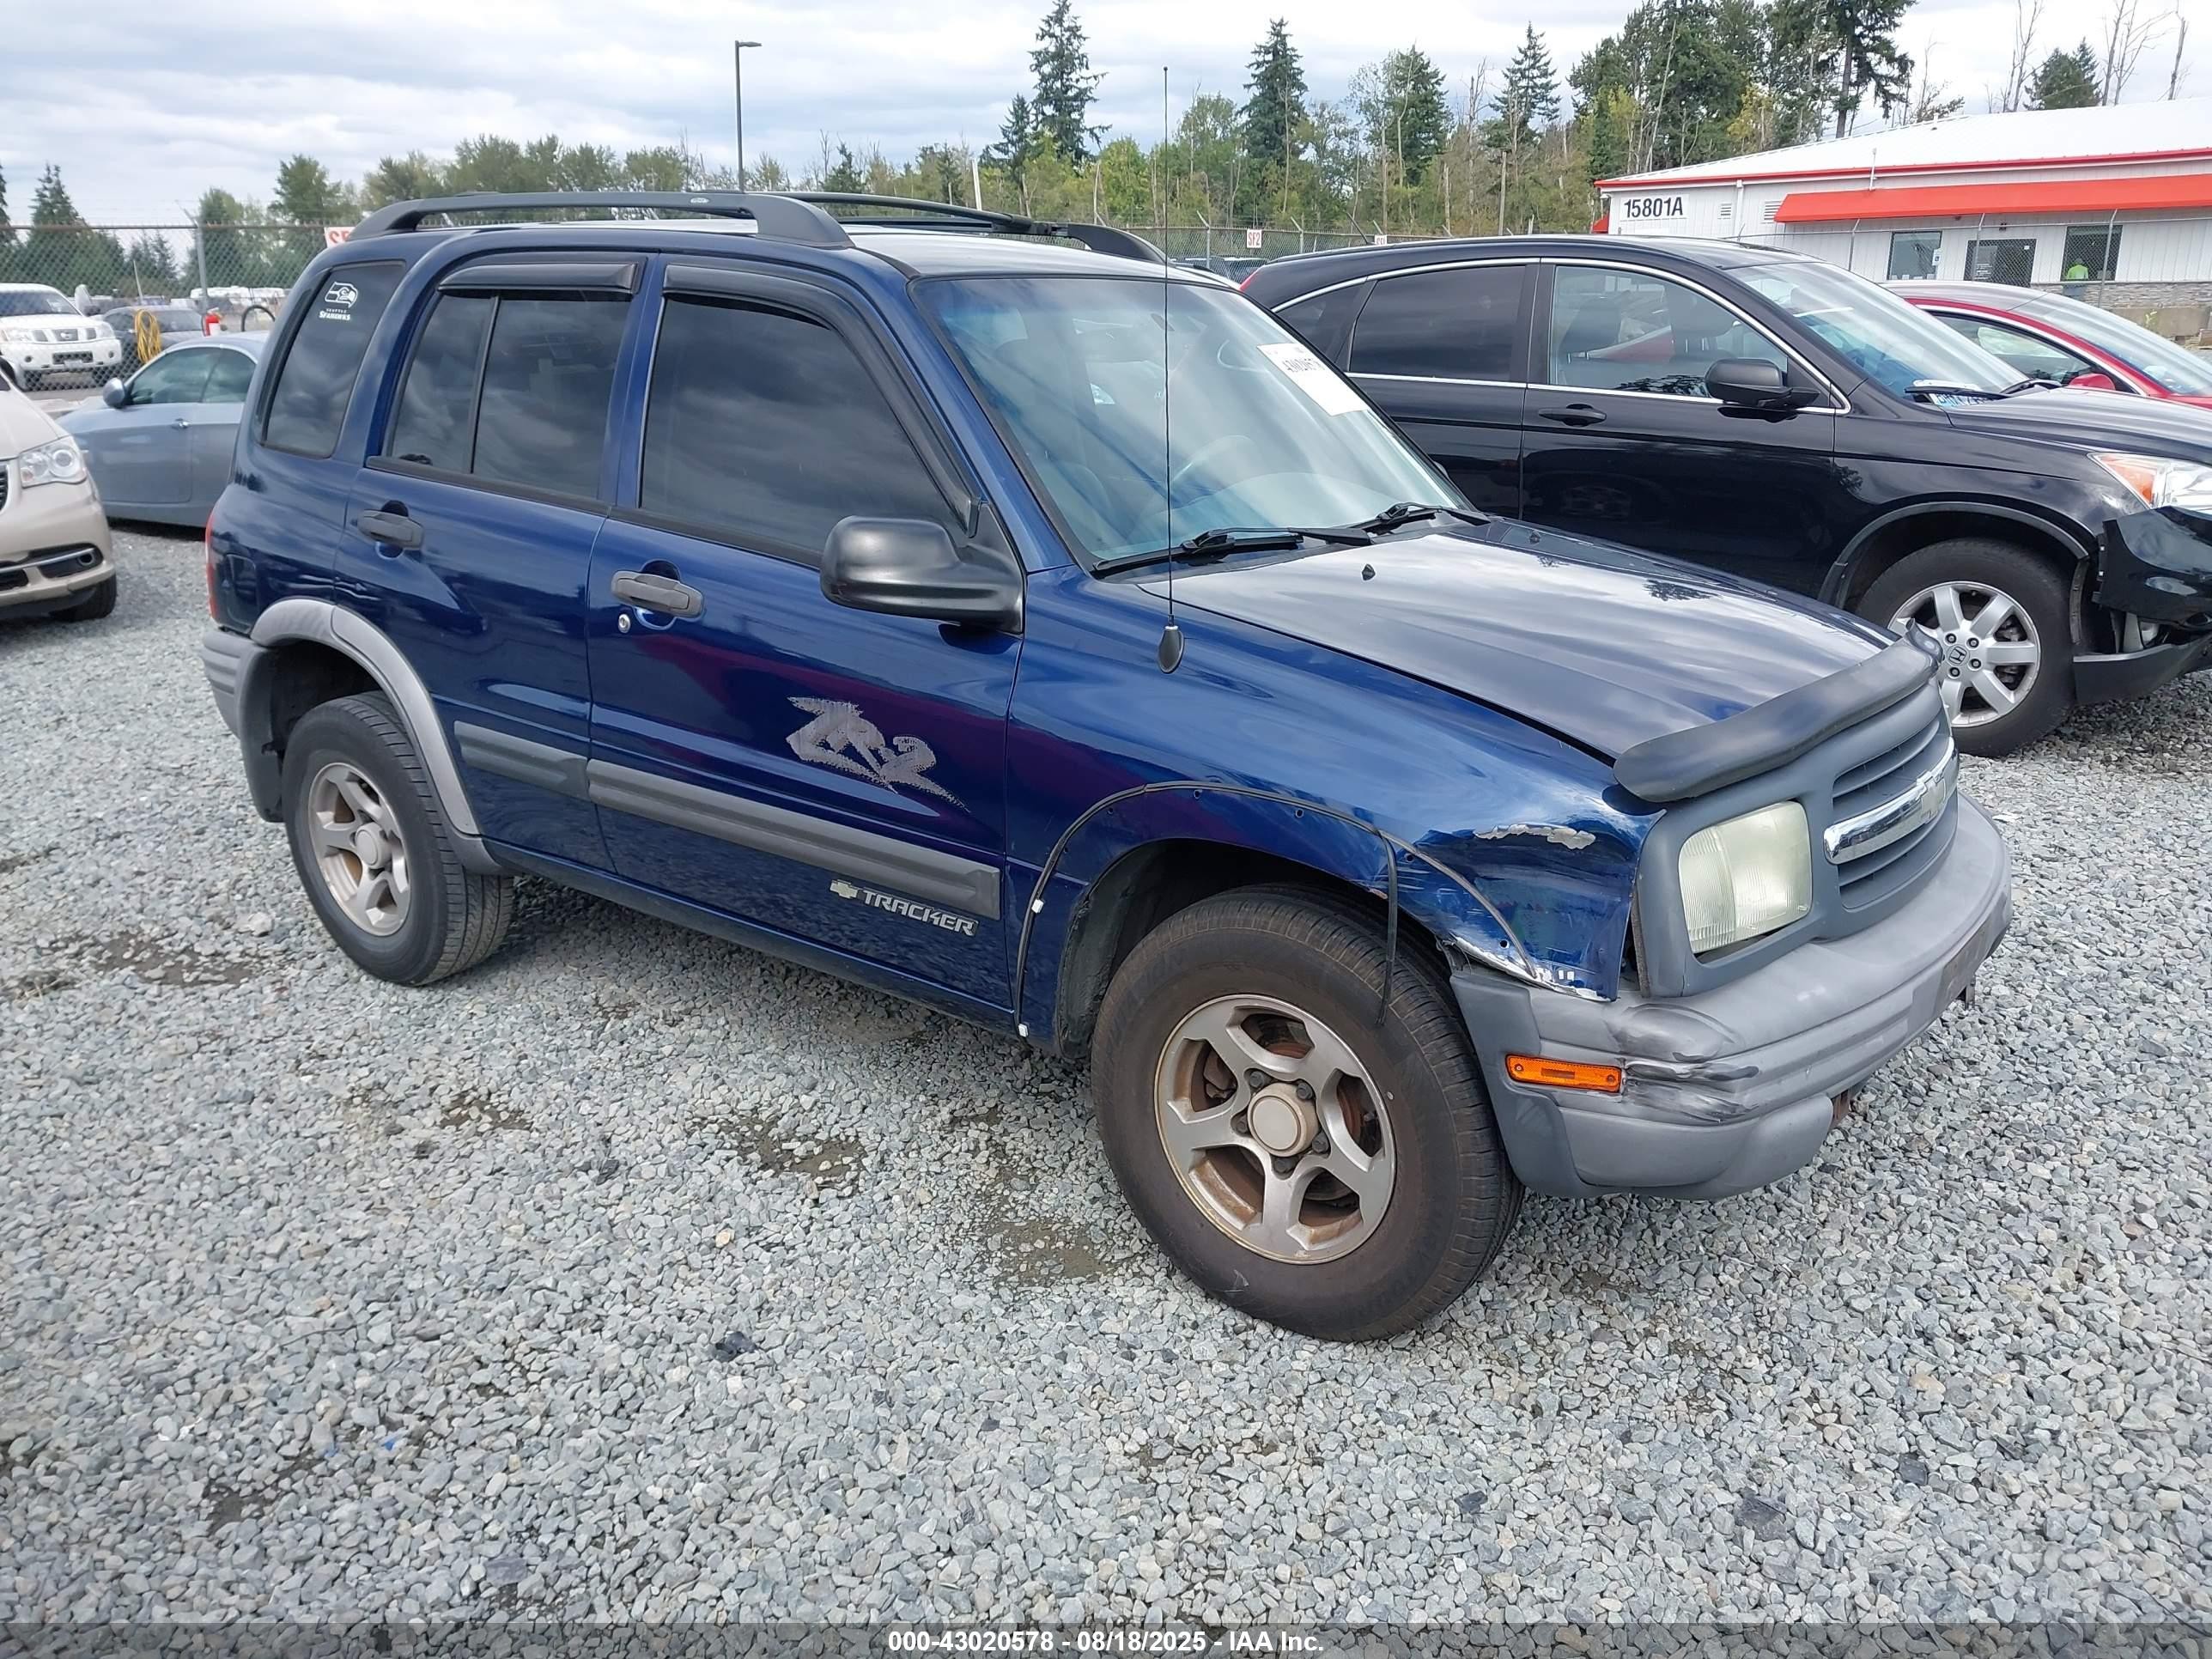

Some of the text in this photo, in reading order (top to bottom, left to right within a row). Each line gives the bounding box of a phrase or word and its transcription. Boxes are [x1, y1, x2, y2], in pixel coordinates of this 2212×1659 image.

[1624, 197, 1683, 218] 15801A
[1248, 232, 1261, 246] SF2
[862, 890, 975, 937] TRACKER
